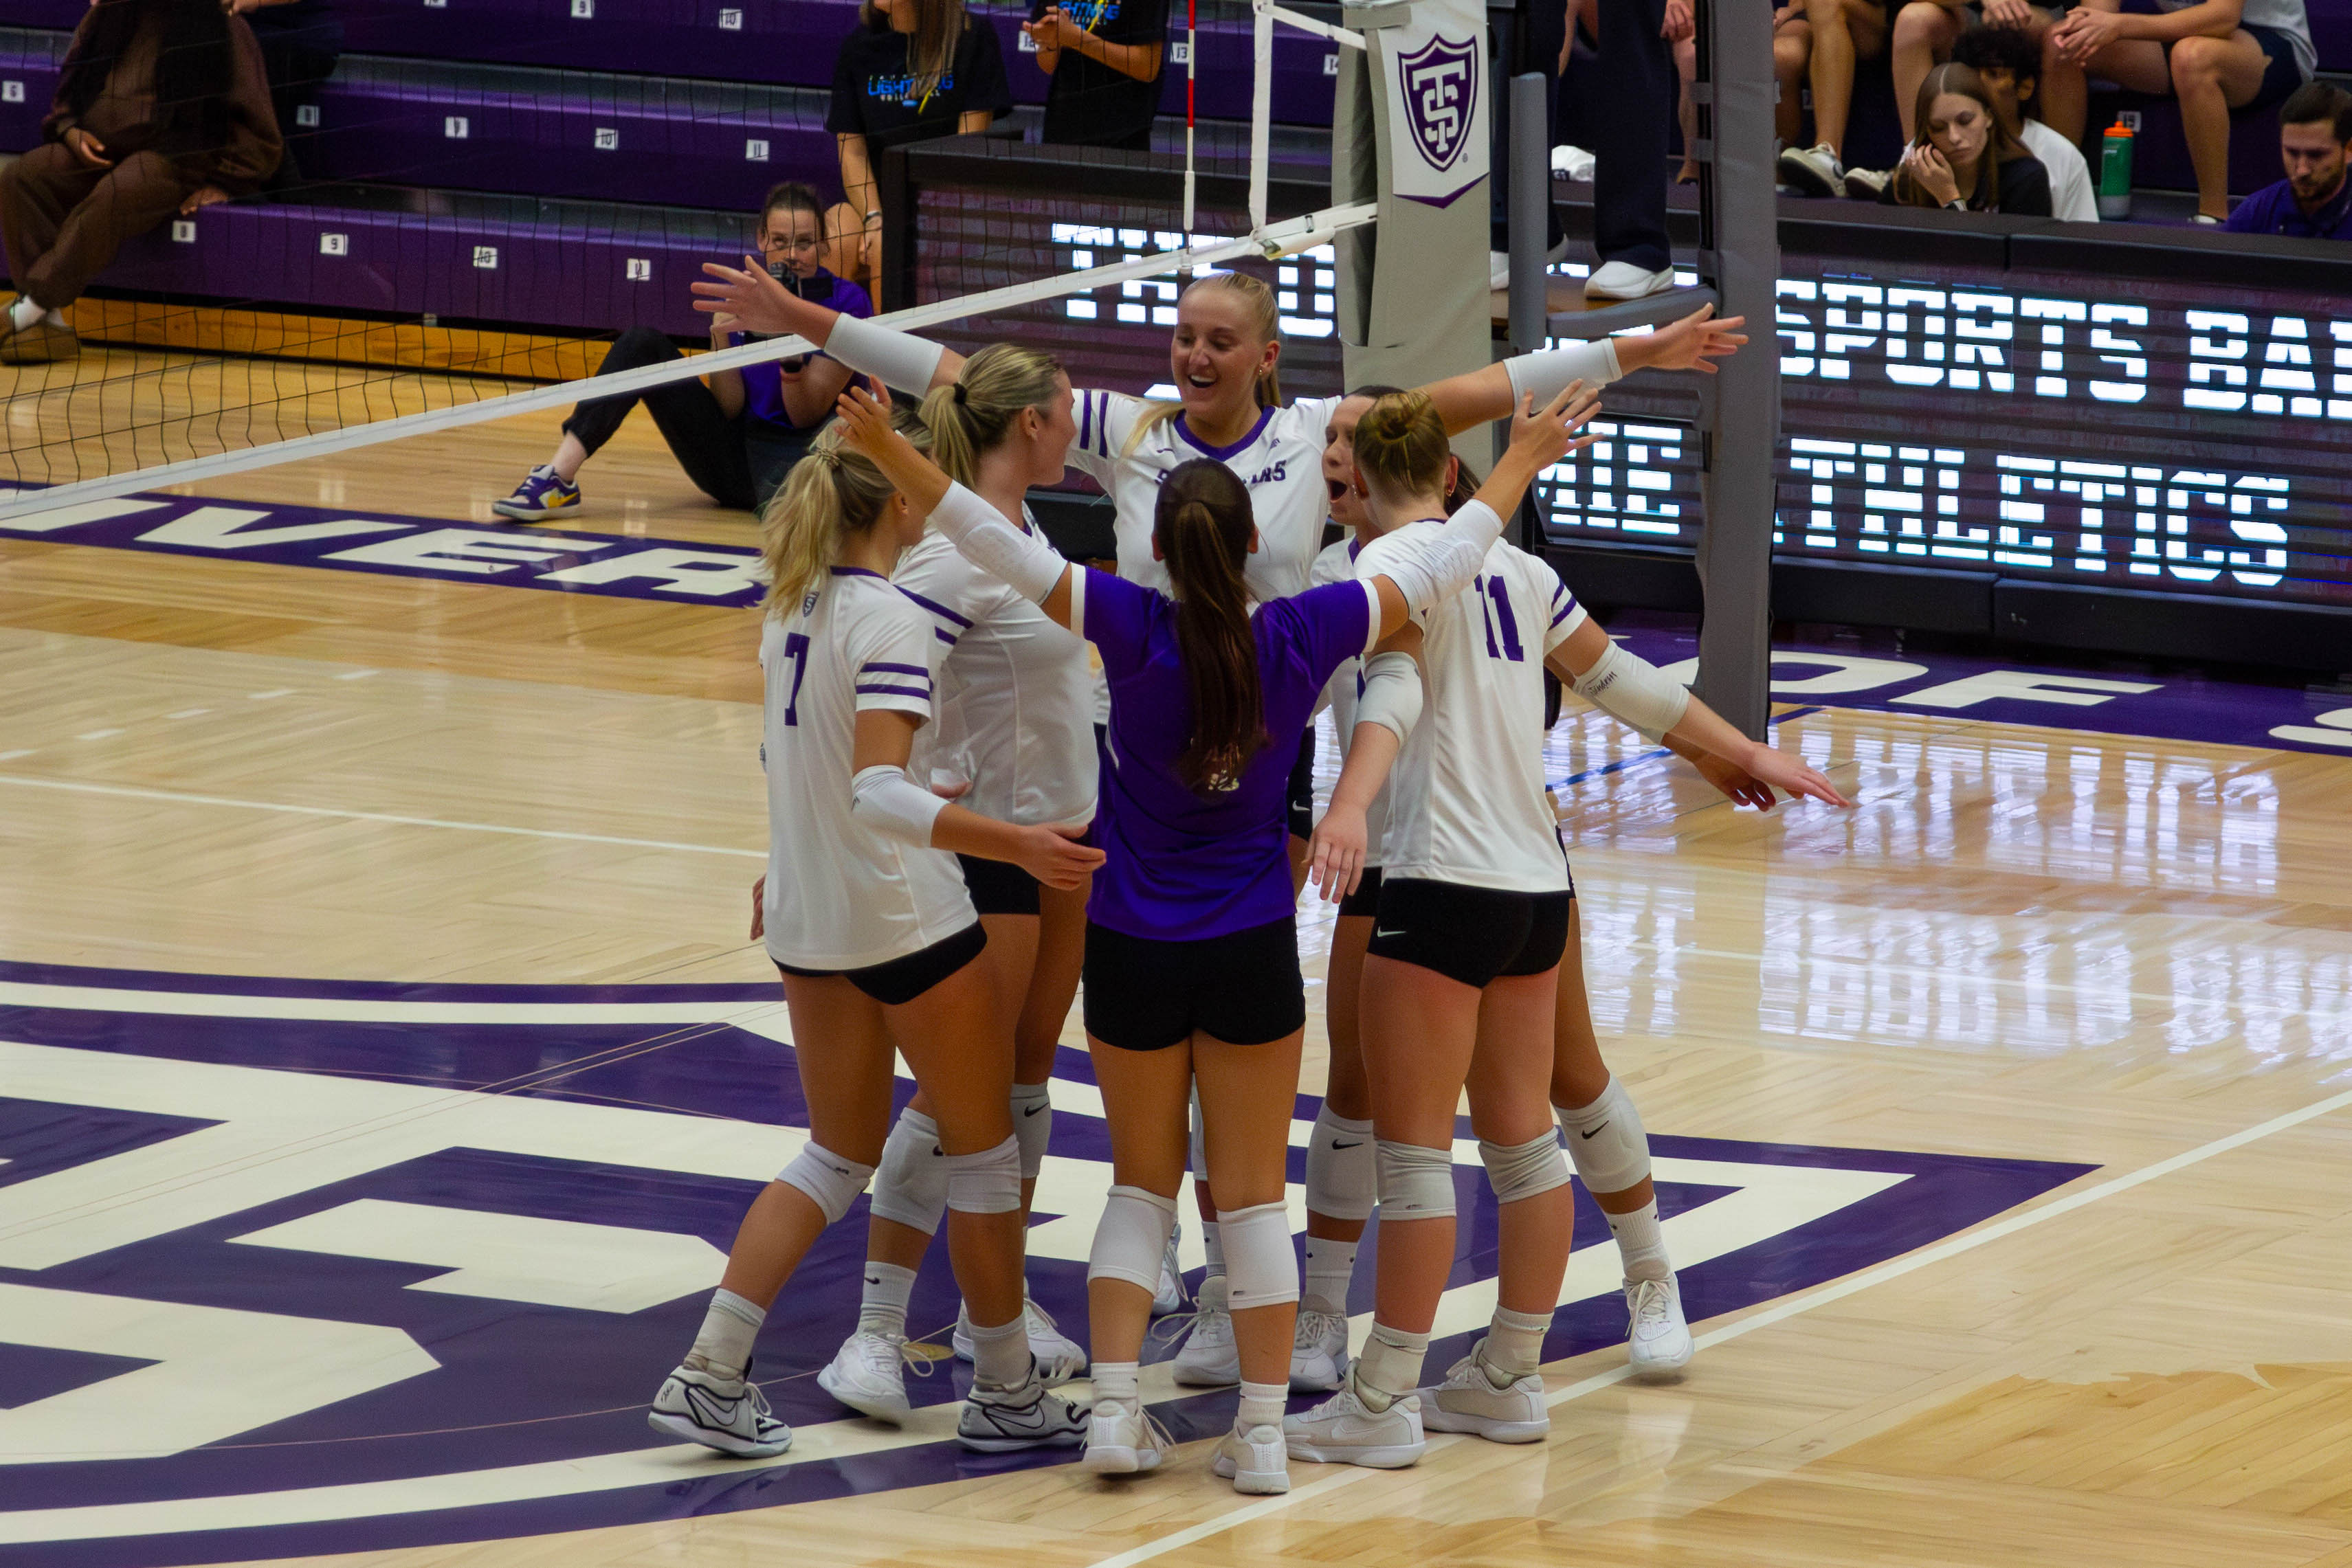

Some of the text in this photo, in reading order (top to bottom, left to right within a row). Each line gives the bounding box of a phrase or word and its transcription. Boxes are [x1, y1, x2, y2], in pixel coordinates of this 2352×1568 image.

[1176, 47, 1187, 59] 13
[753, 144, 761, 157] 11
[331, 238, 338, 251] 9
[1775, 279, 2148, 403] SPORTS
[1773, 438, 2290, 586] THLETICS
[1472, 574, 1524, 662] 11
[784, 632, 810, 726] 7
